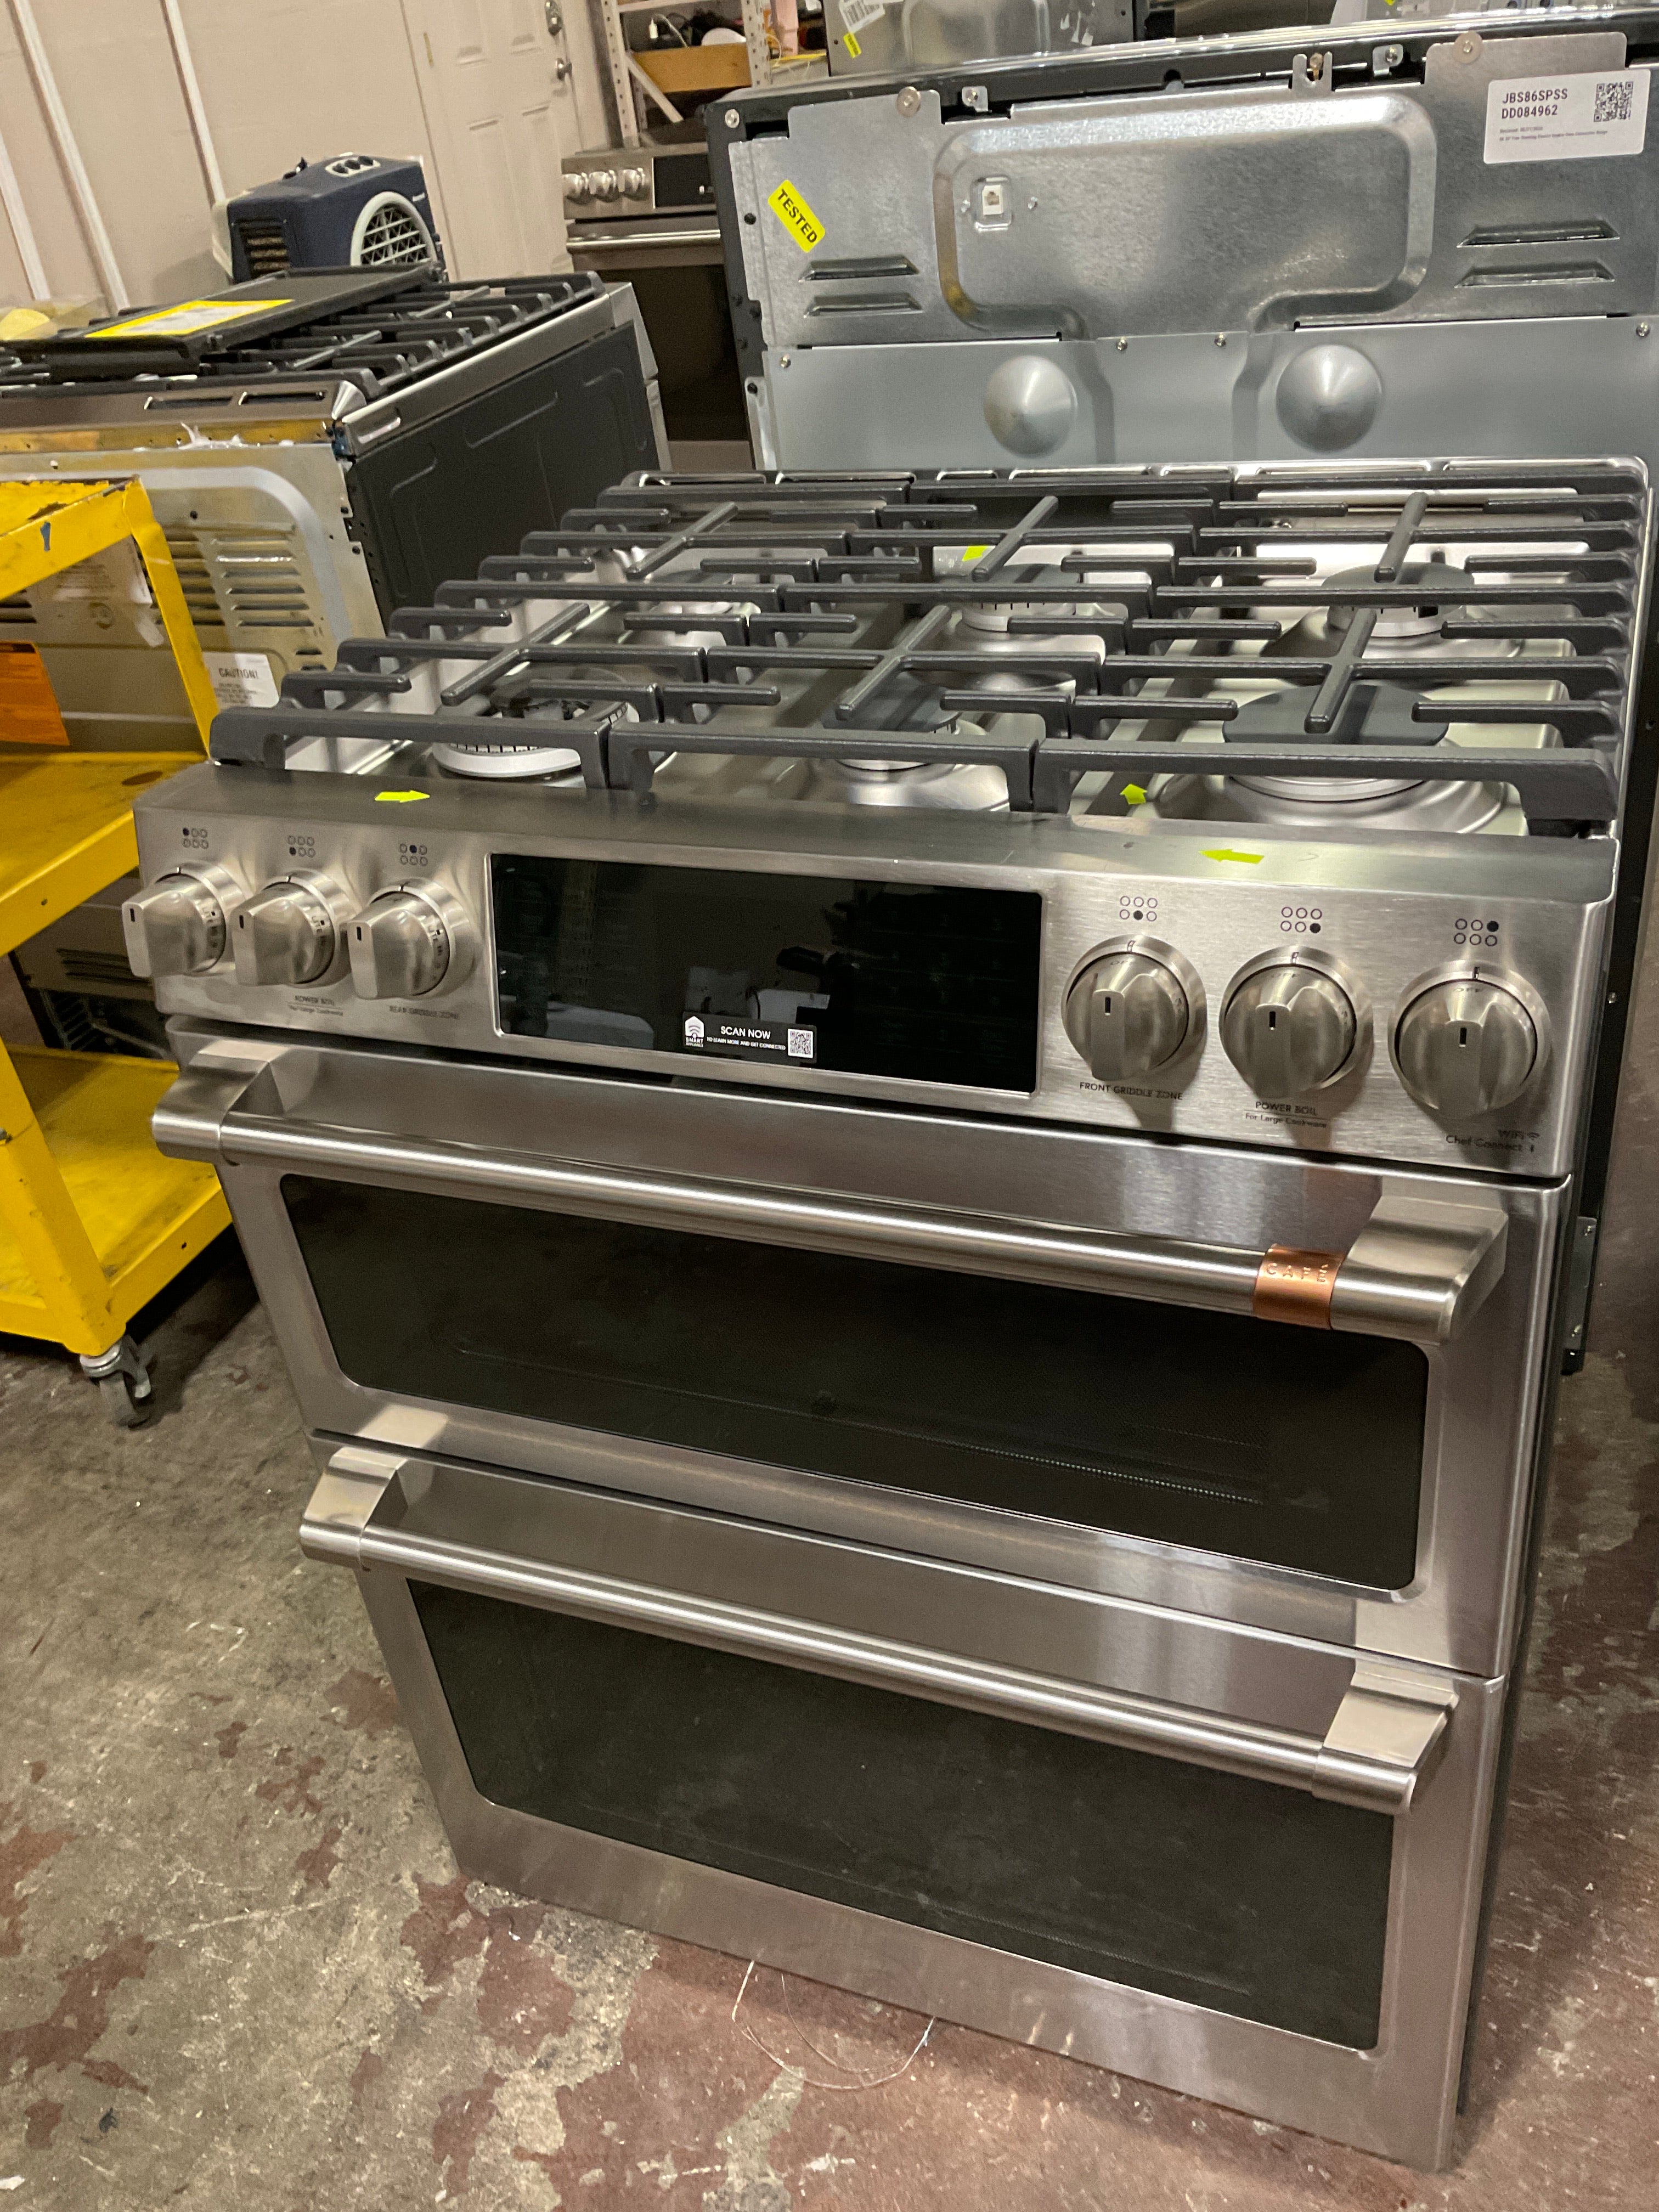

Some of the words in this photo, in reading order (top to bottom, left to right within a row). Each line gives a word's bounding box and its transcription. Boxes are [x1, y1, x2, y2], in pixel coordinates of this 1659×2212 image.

[1502, 88, 1568, 104] JBS86SPSS
[1502, 104, 1558, 119] DD084962
[777, 188, 817, 243] TESTED
[720, 1026, 746, 1037] SCAN
[748, 1029, 771, 1040] NOW
[1080, 1082, 1111, 1092] FRONT
[1113, 1085, 1152, 1097] GRIDDLE
[1155, 1090, 1183, 1100] ZONE
[1255, 1101, 1291, 1112] POWER
[1261, 1114, 1283, 1125] Large
[1267, 1263, 1328, 1283] CAFÉ
